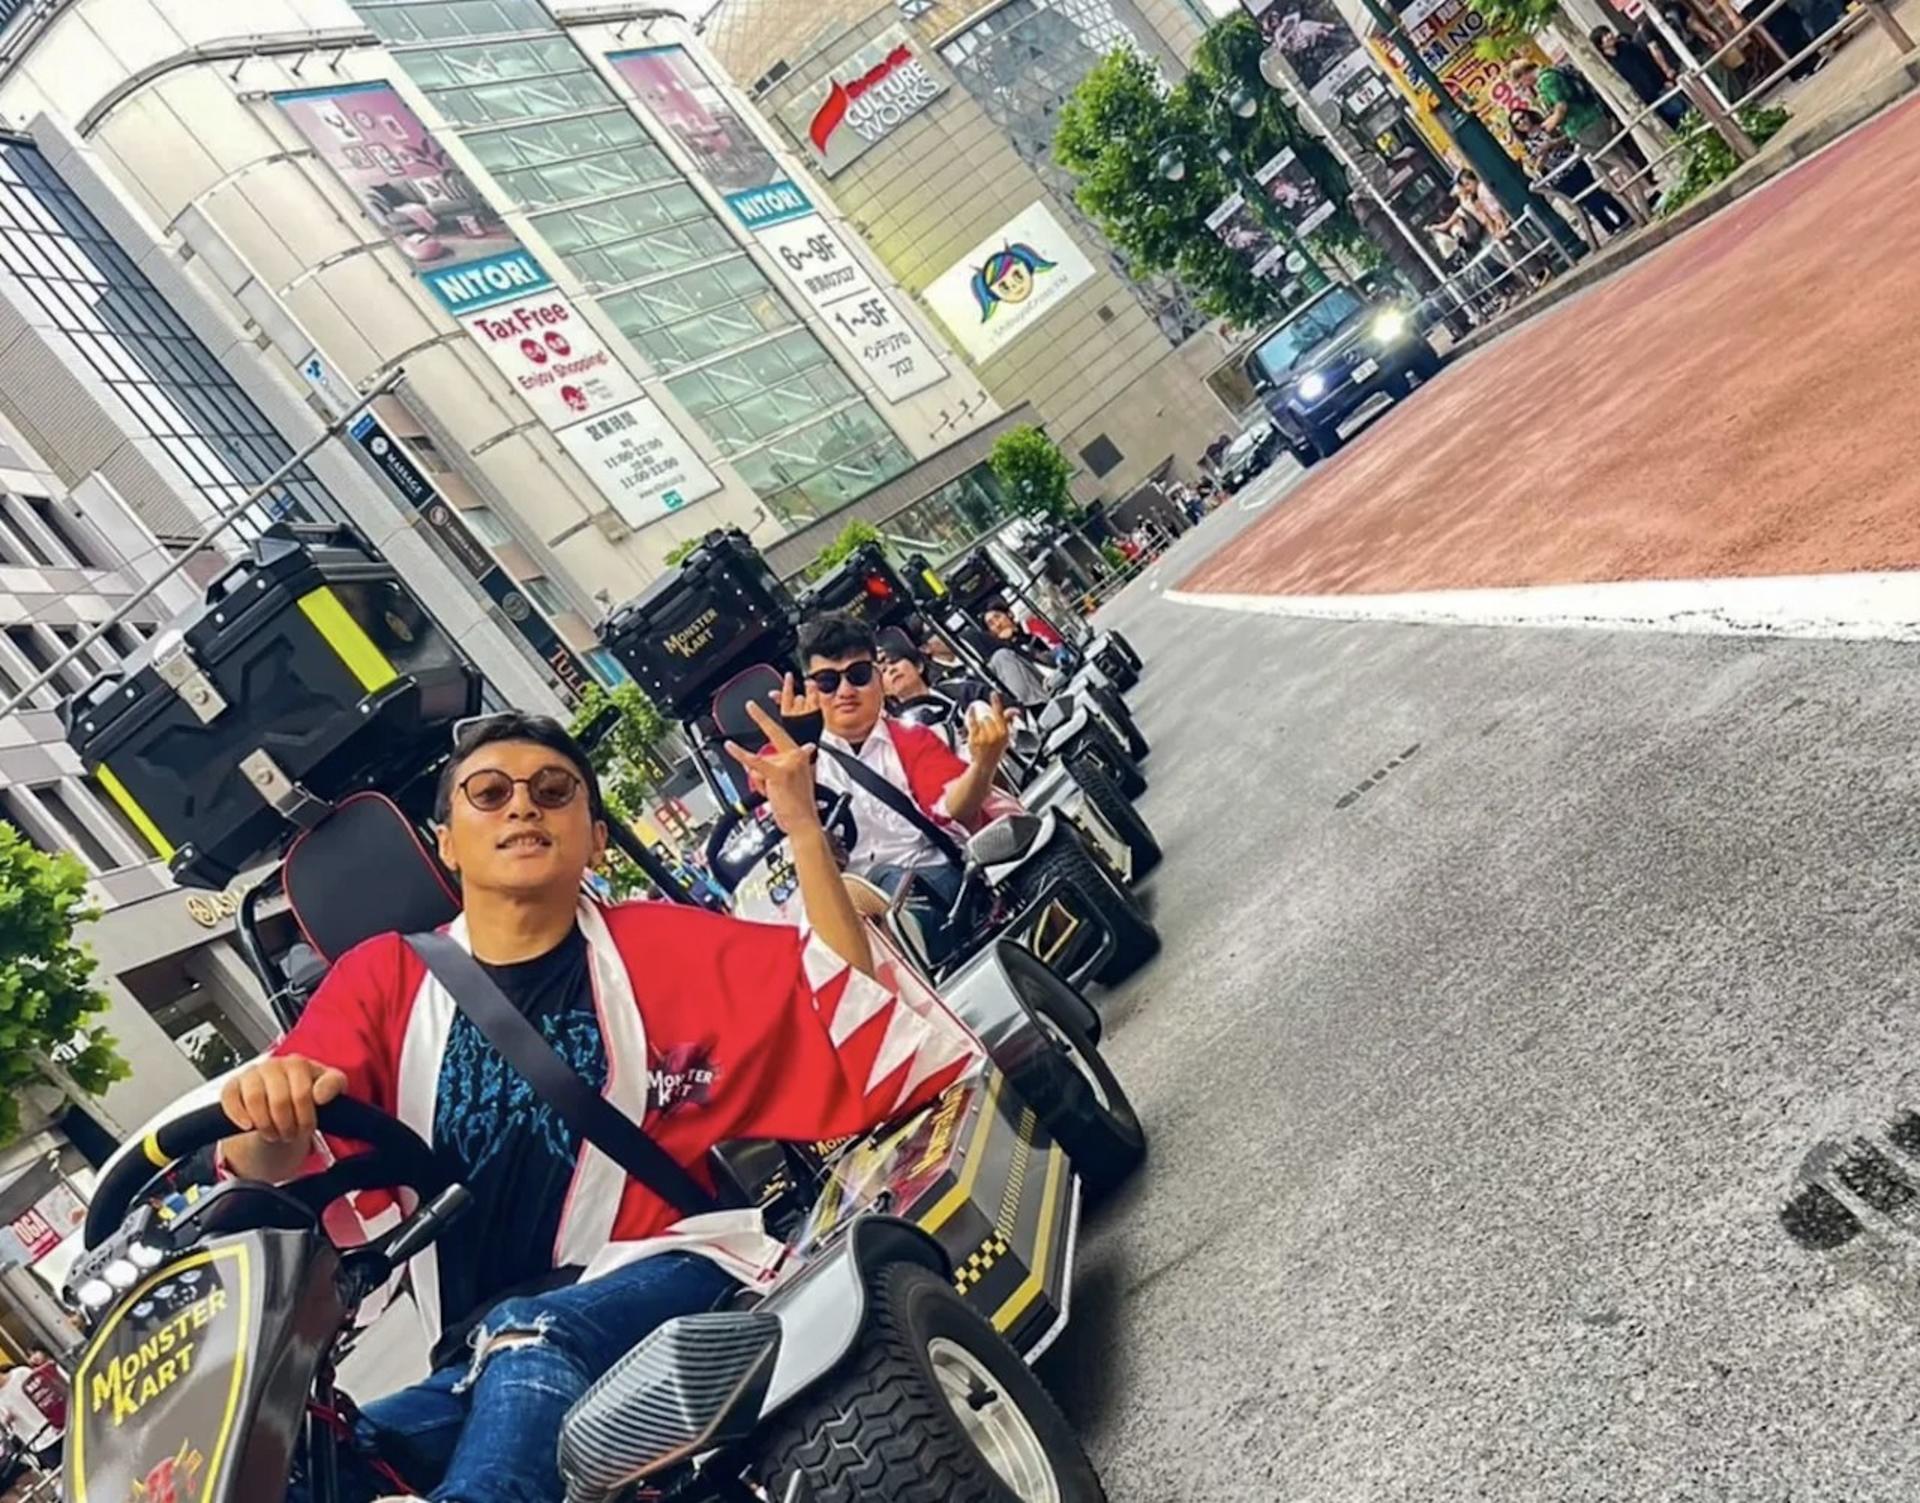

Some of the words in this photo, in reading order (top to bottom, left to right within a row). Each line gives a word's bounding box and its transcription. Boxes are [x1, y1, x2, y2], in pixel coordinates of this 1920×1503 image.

[845, 60, 927, 126] CULTURE
[856, 78, 939, 140] WORKS
[734, 187, 804, 219] NITORI
[434, 257, 540, 303] NITORI
[387, 451, 423, 495] MASSAGE
[663, 608, 718, 654] MONSTER
[677, 628, 714, 658] KART
[92, 1283, 228, 1413] MONSTER
[113, 1342, 195, 1427] KART
